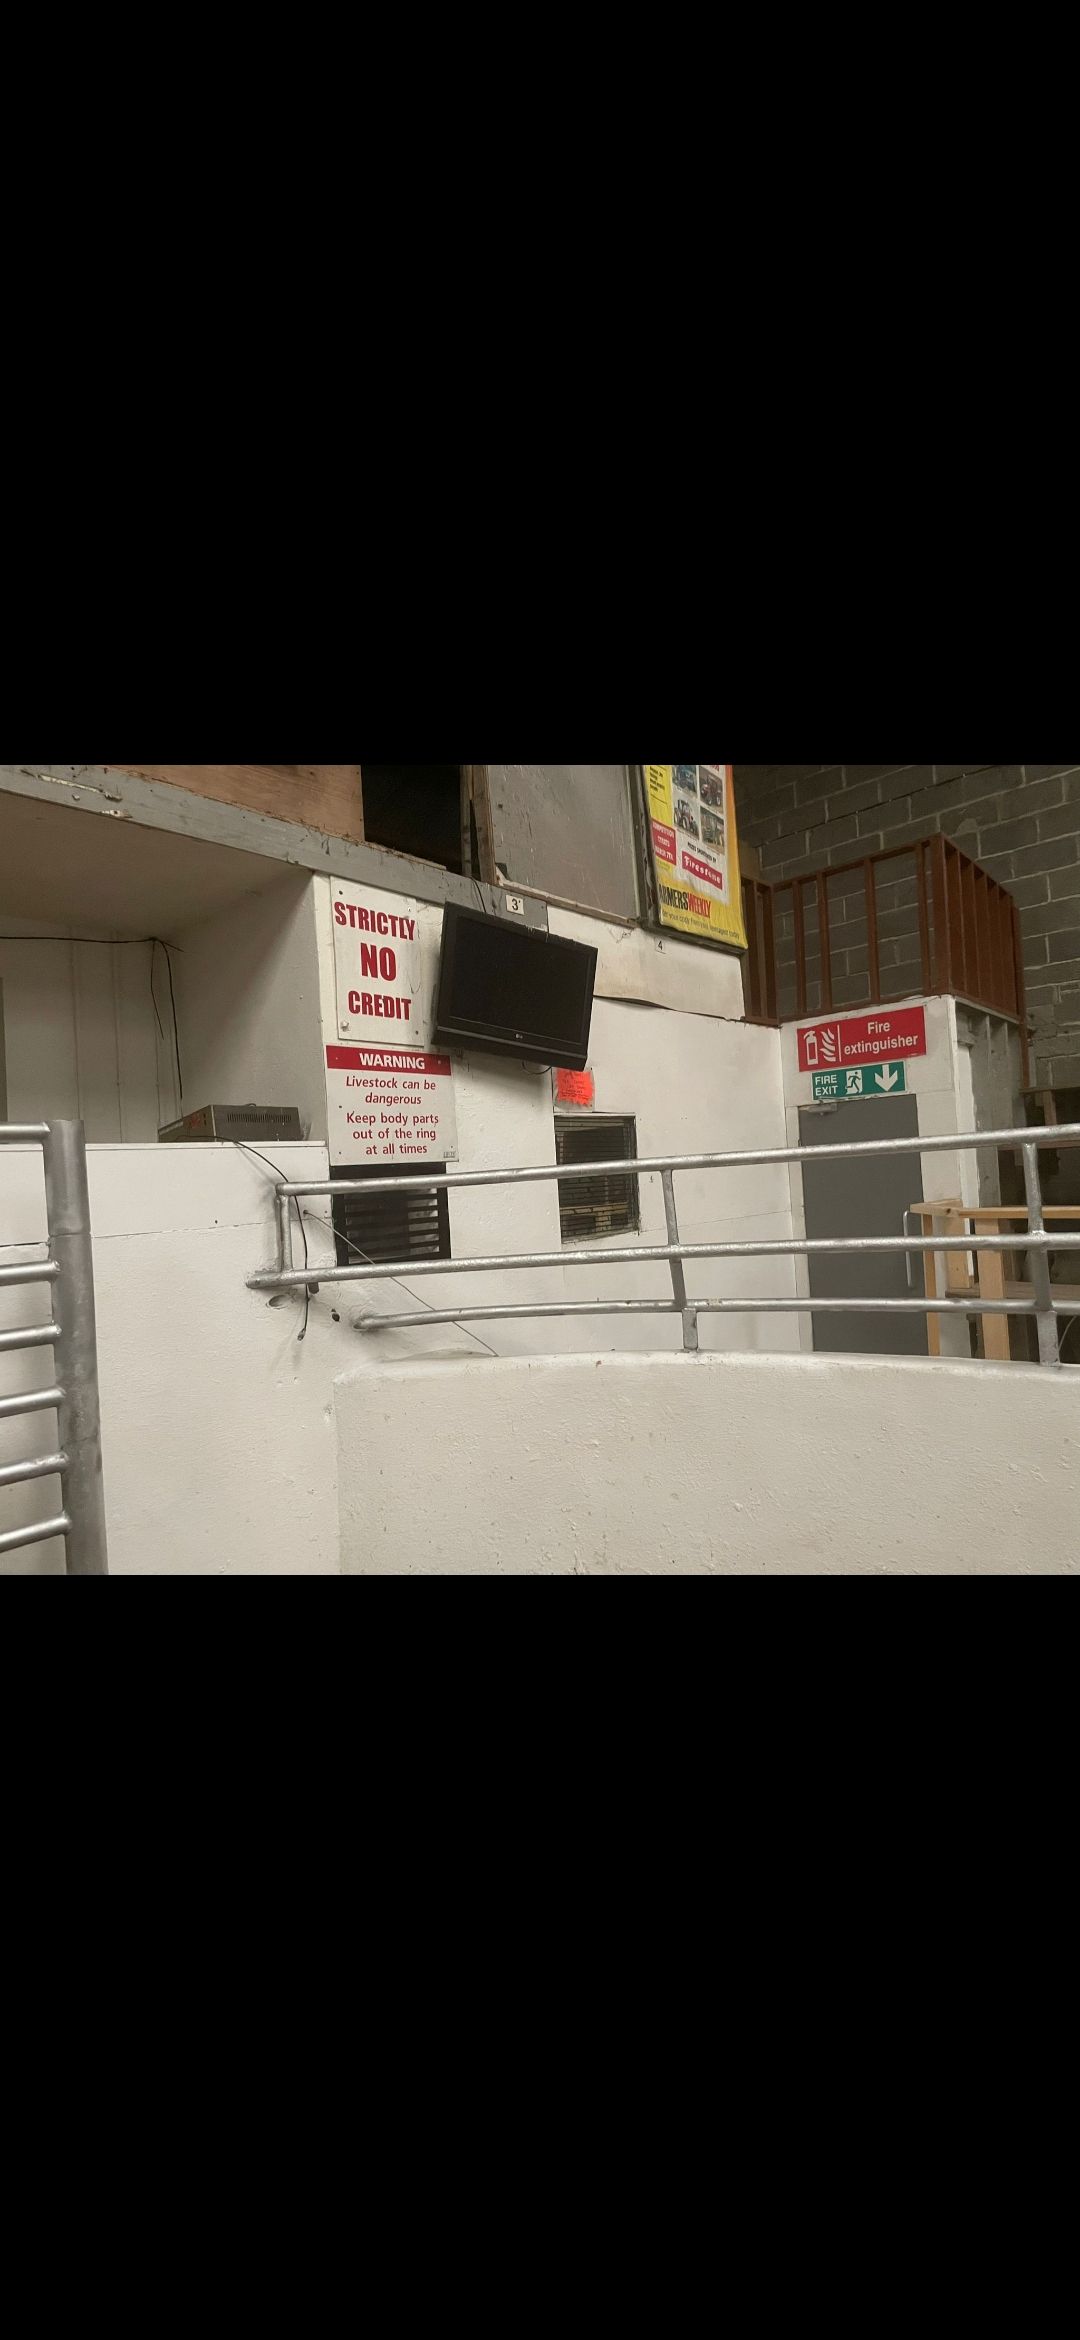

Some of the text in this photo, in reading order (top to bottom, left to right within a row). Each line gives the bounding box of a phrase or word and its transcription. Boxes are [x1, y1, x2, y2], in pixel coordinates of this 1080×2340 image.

[684, 855, 721, 884] Firestone
[334, 901, 415, 941] STRICTLY
[657, 940, 663, 951] 4
[360, 942, 397, 981] NO
[348, 990, 412, 1020] CREDIT
[867, 1021, 891, 1035] Fire
[844, 1035, 918, 1055] extinguisher
[359, 1052, 425, 1070] WARNING
[346, 1075, 436, 1090] Livestock can be
[815, 1074, 838, 1086] FIRE
[815, 1085, 839, 1096] EXIT
[365, 1092, 422, 1107] dangerous
[346, 1112, 439, 1126] Keep body parts
[352, 1127, 436, 1141] out of the ring
[365, 1143, 427, 1155] at all times
